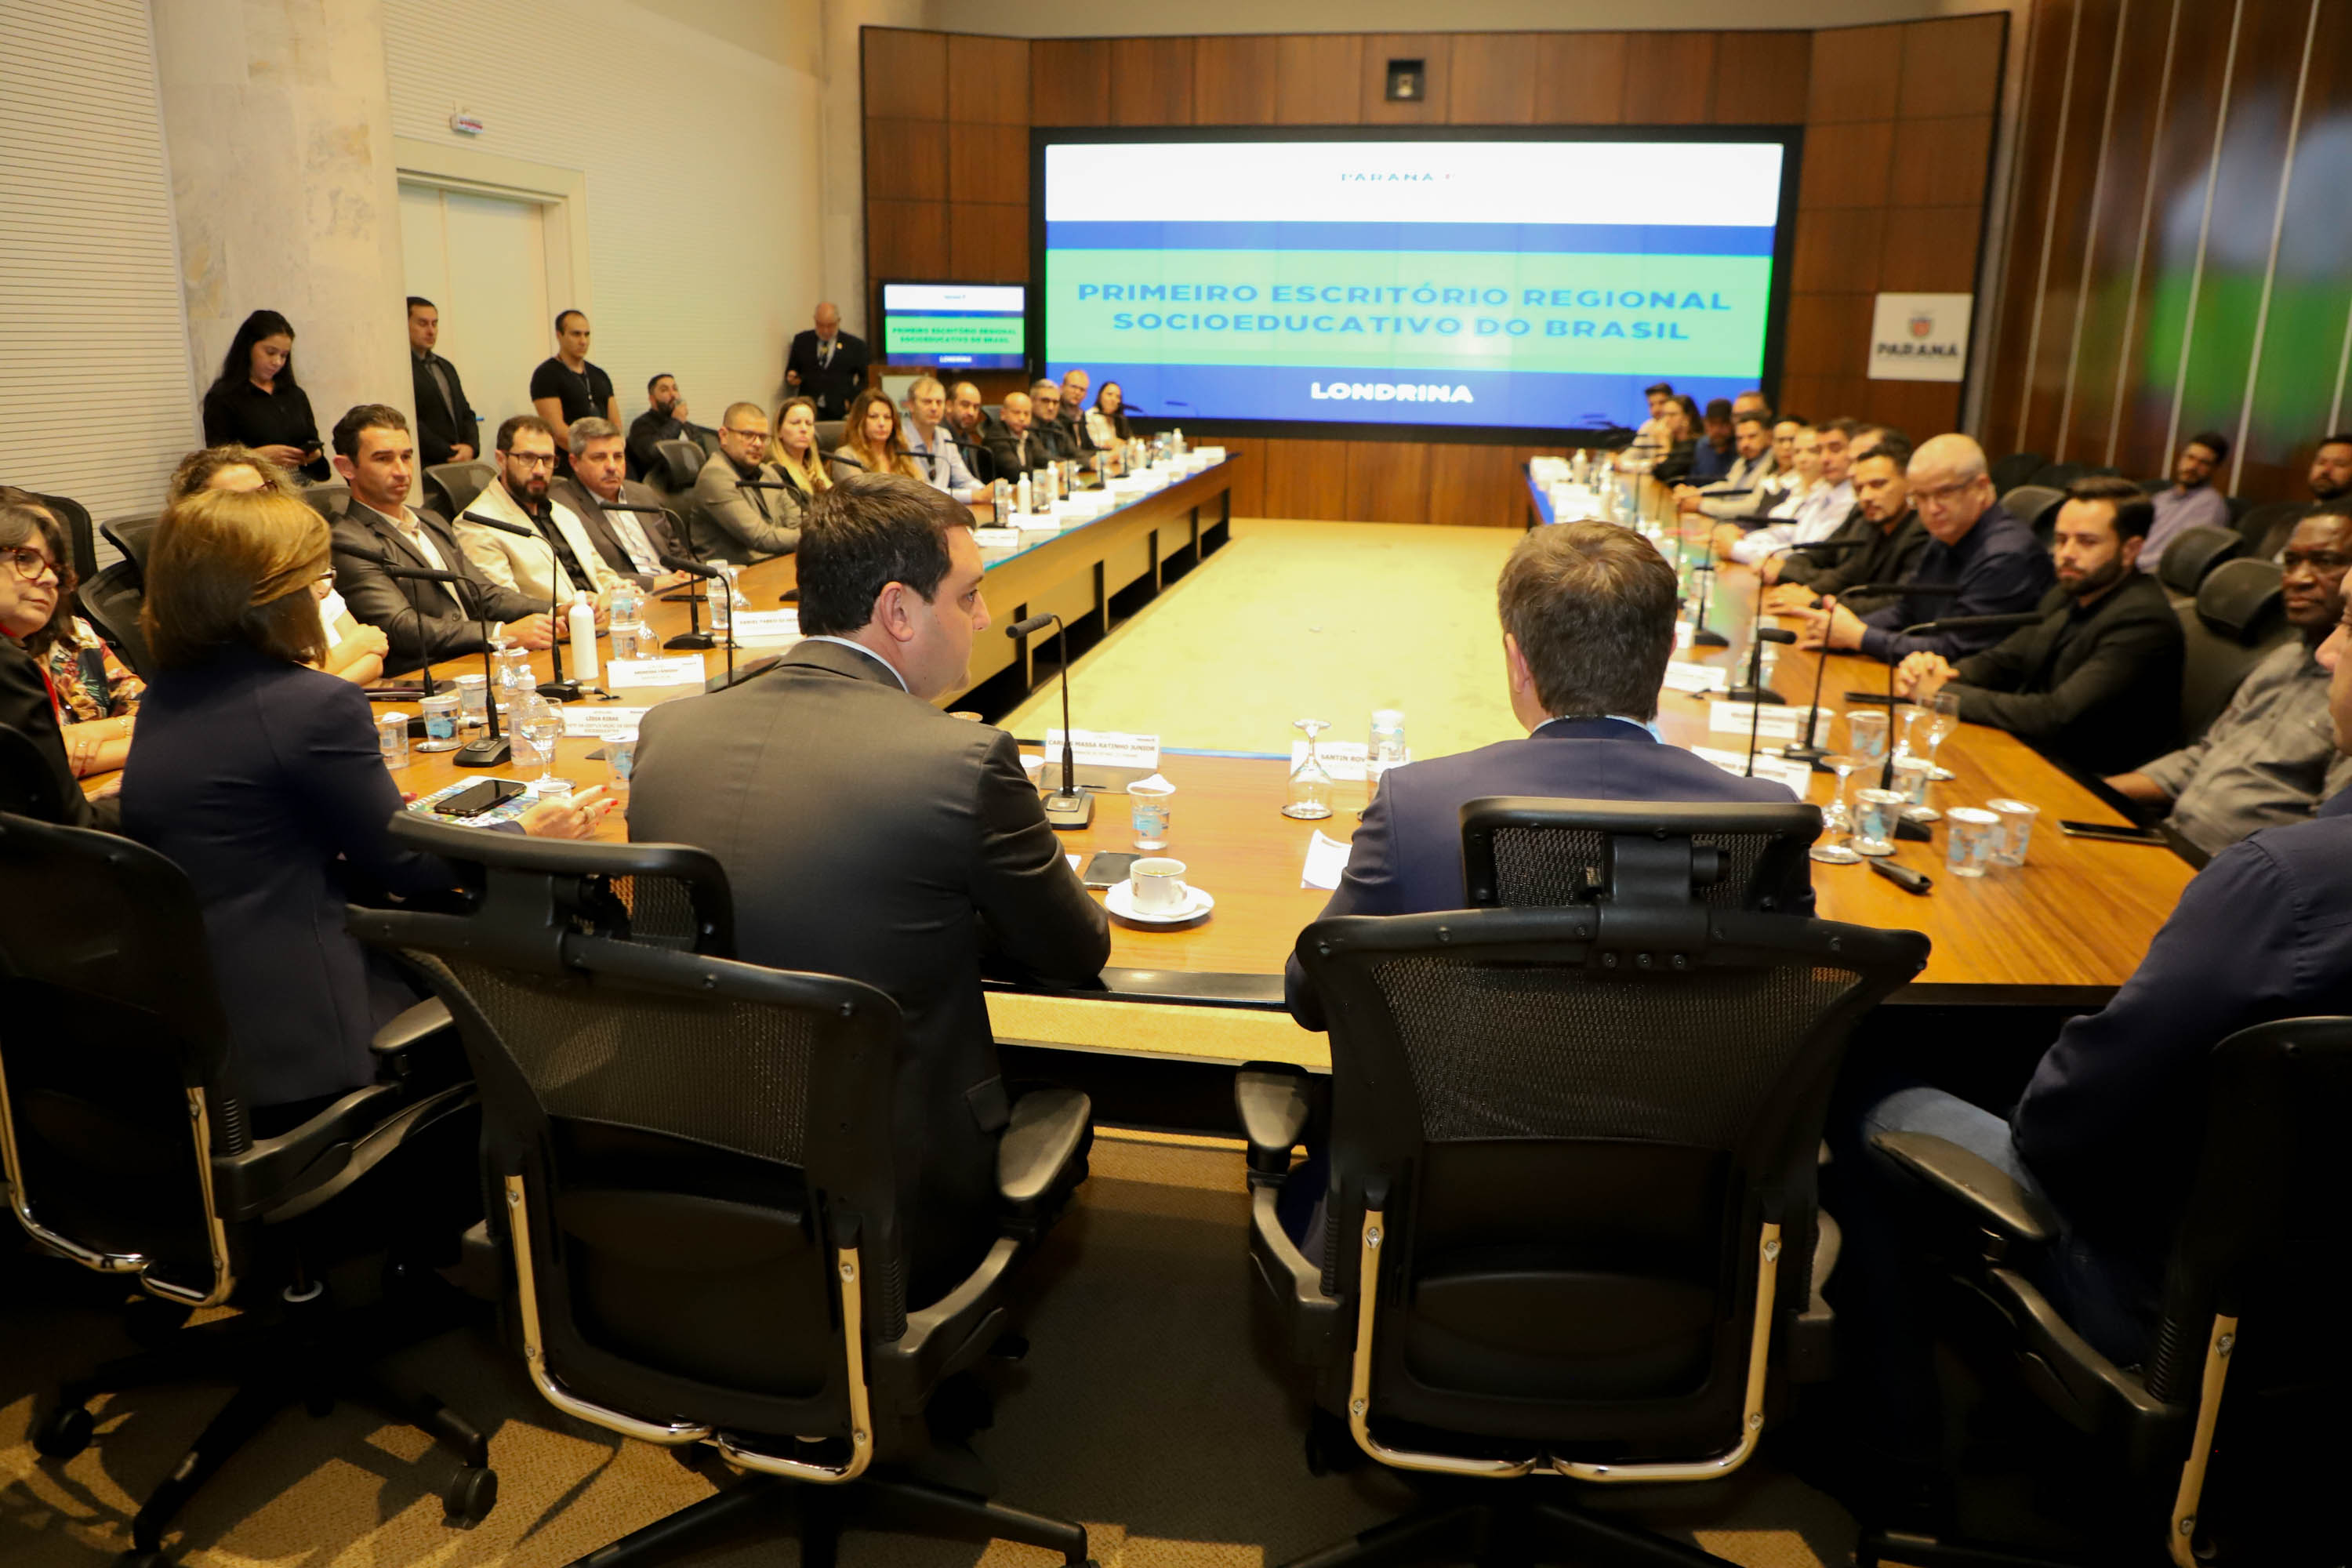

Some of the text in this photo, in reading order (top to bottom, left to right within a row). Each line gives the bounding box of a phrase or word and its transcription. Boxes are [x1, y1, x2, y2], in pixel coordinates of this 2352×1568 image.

[1078, 281, 1732, 311] PRIMEIRO ESCRITÓRIO REGIONAL
[1112, 313, 1690, 341] SOCIOEDUCATIVO DO BRASIL
[1310, 382, 1474, 403] LONDRINA
